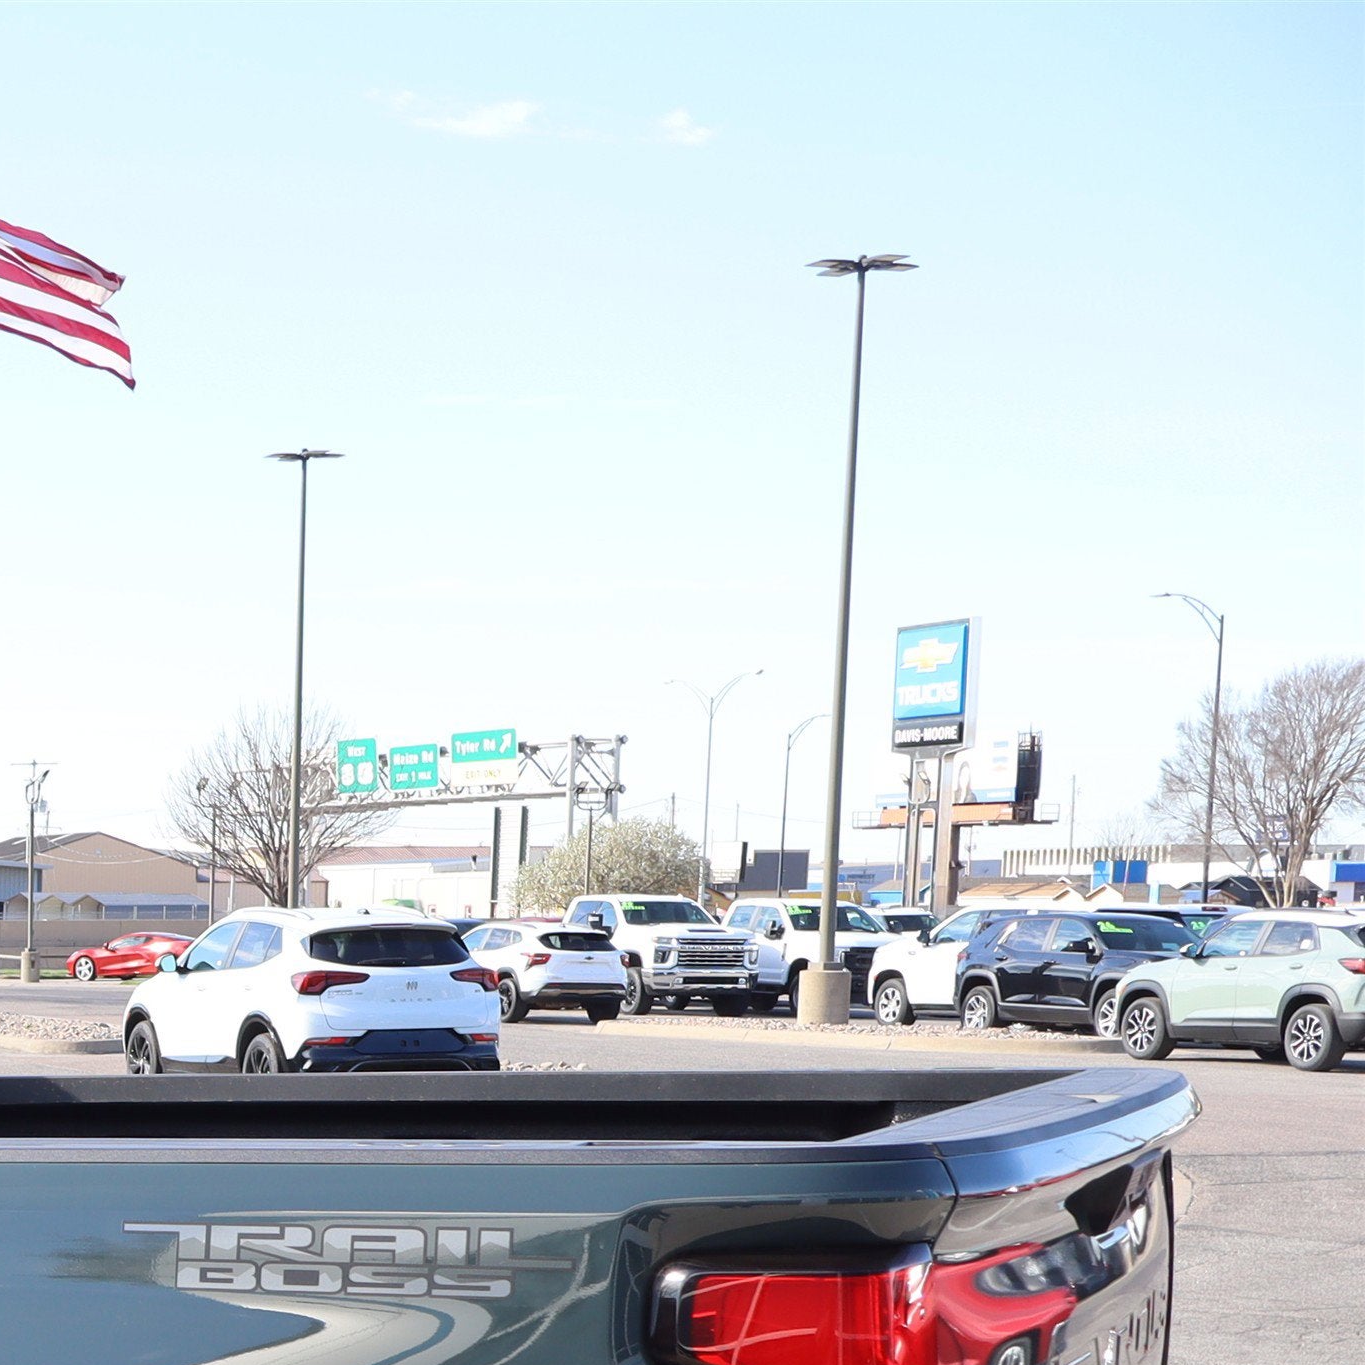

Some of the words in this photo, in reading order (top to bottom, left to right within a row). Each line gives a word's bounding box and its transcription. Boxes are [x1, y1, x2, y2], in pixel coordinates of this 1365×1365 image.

[897, 681, 959, 706] TRUCKS
[894, 725, 959, 744] DAVIS-MOORE
[454, 741, 481, 756] Tyler
[482, 739, 496, 752] Rd
[421, 751, 434, 764] Rd
[483, 768, 502, 778] ONLY
[122, 1220, 576, 1269] TRAIL
[175, 1260, 516, 1299] BOSS
